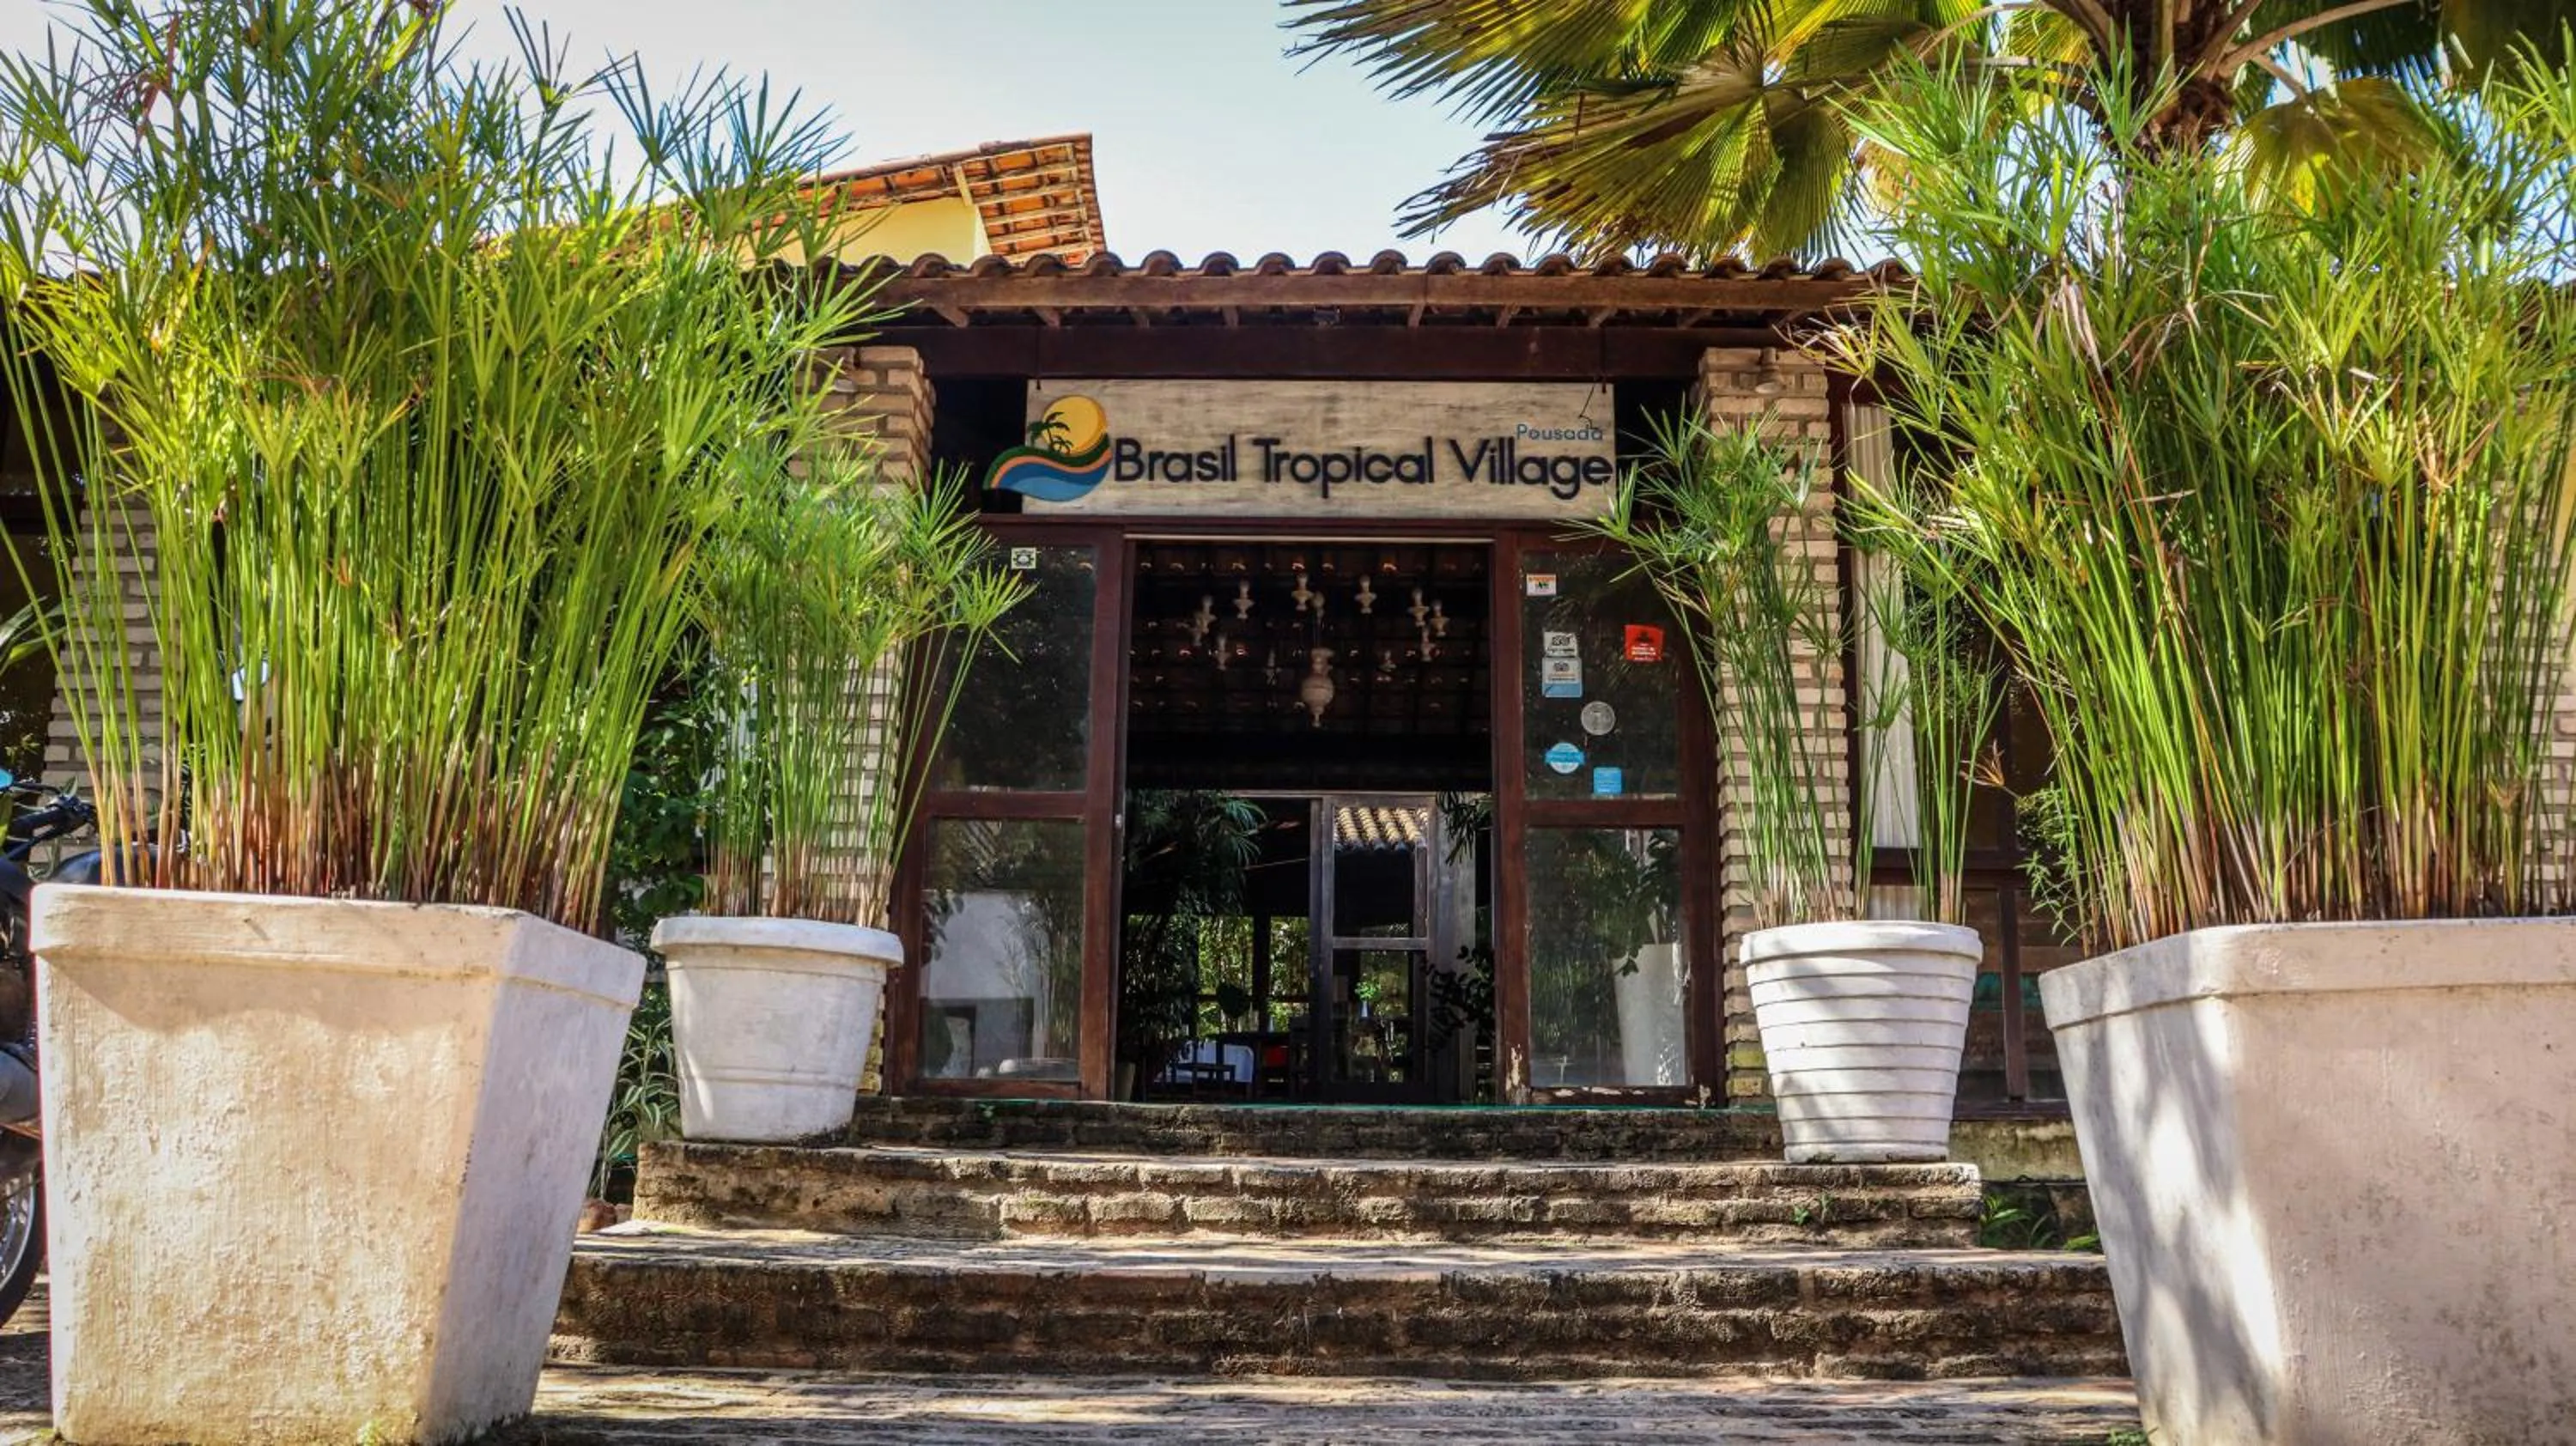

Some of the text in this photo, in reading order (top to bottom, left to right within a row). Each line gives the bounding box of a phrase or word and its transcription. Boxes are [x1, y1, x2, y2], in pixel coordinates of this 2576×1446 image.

[1516, 424, 1604, 440] Pousada
[1115, 434, 1614, 500] Brasil Tropical Village
